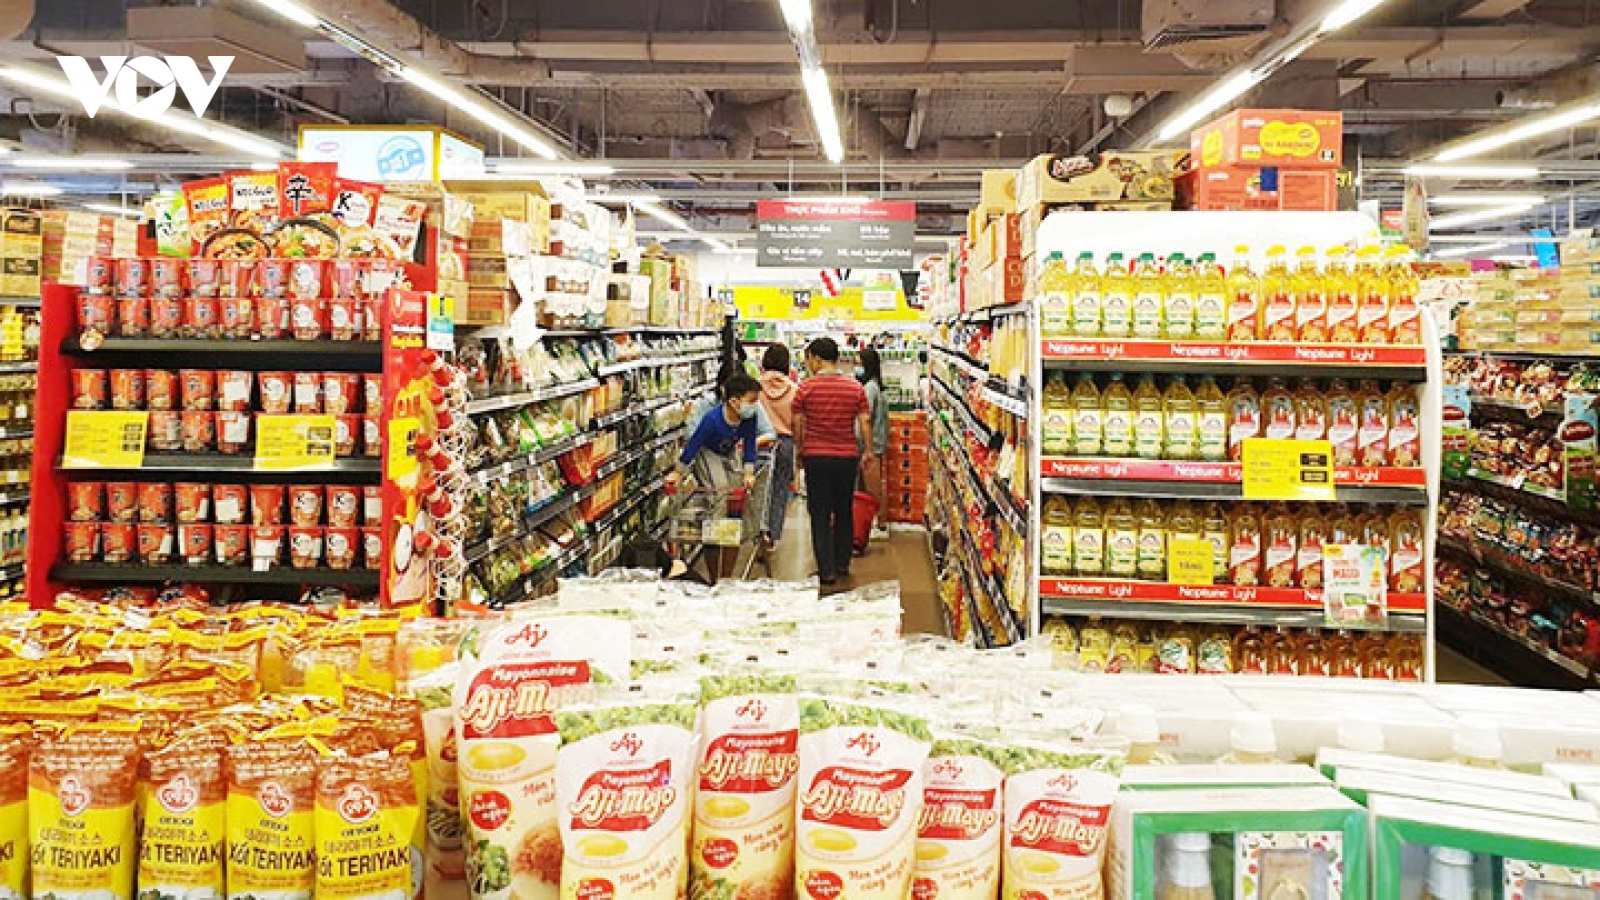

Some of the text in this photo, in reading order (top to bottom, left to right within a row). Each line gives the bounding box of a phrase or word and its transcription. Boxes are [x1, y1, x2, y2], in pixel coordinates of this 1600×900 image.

[1048, 343, 1097, 356] Neptune
[1170, 345, 1220, 358] Neptune
[1295, 347, 1346, 361] Neptune
[1051, 462, 1100, 475] Neptune
[1174, 465, 1223, 479] Neptune
[1056, 582, 1105, 596] Neptune
[1178, 586, 1229, 599] Neptune
[491, 664, 577, 683] Mayonnaise
[700, 749, 799, 790] Aji-Mayo
[568, 786, 676, 828] Aji-Mayo
[51, 843, 121, 870] TERIYAKI
[338, 846, 411, 876] TERIYAK
